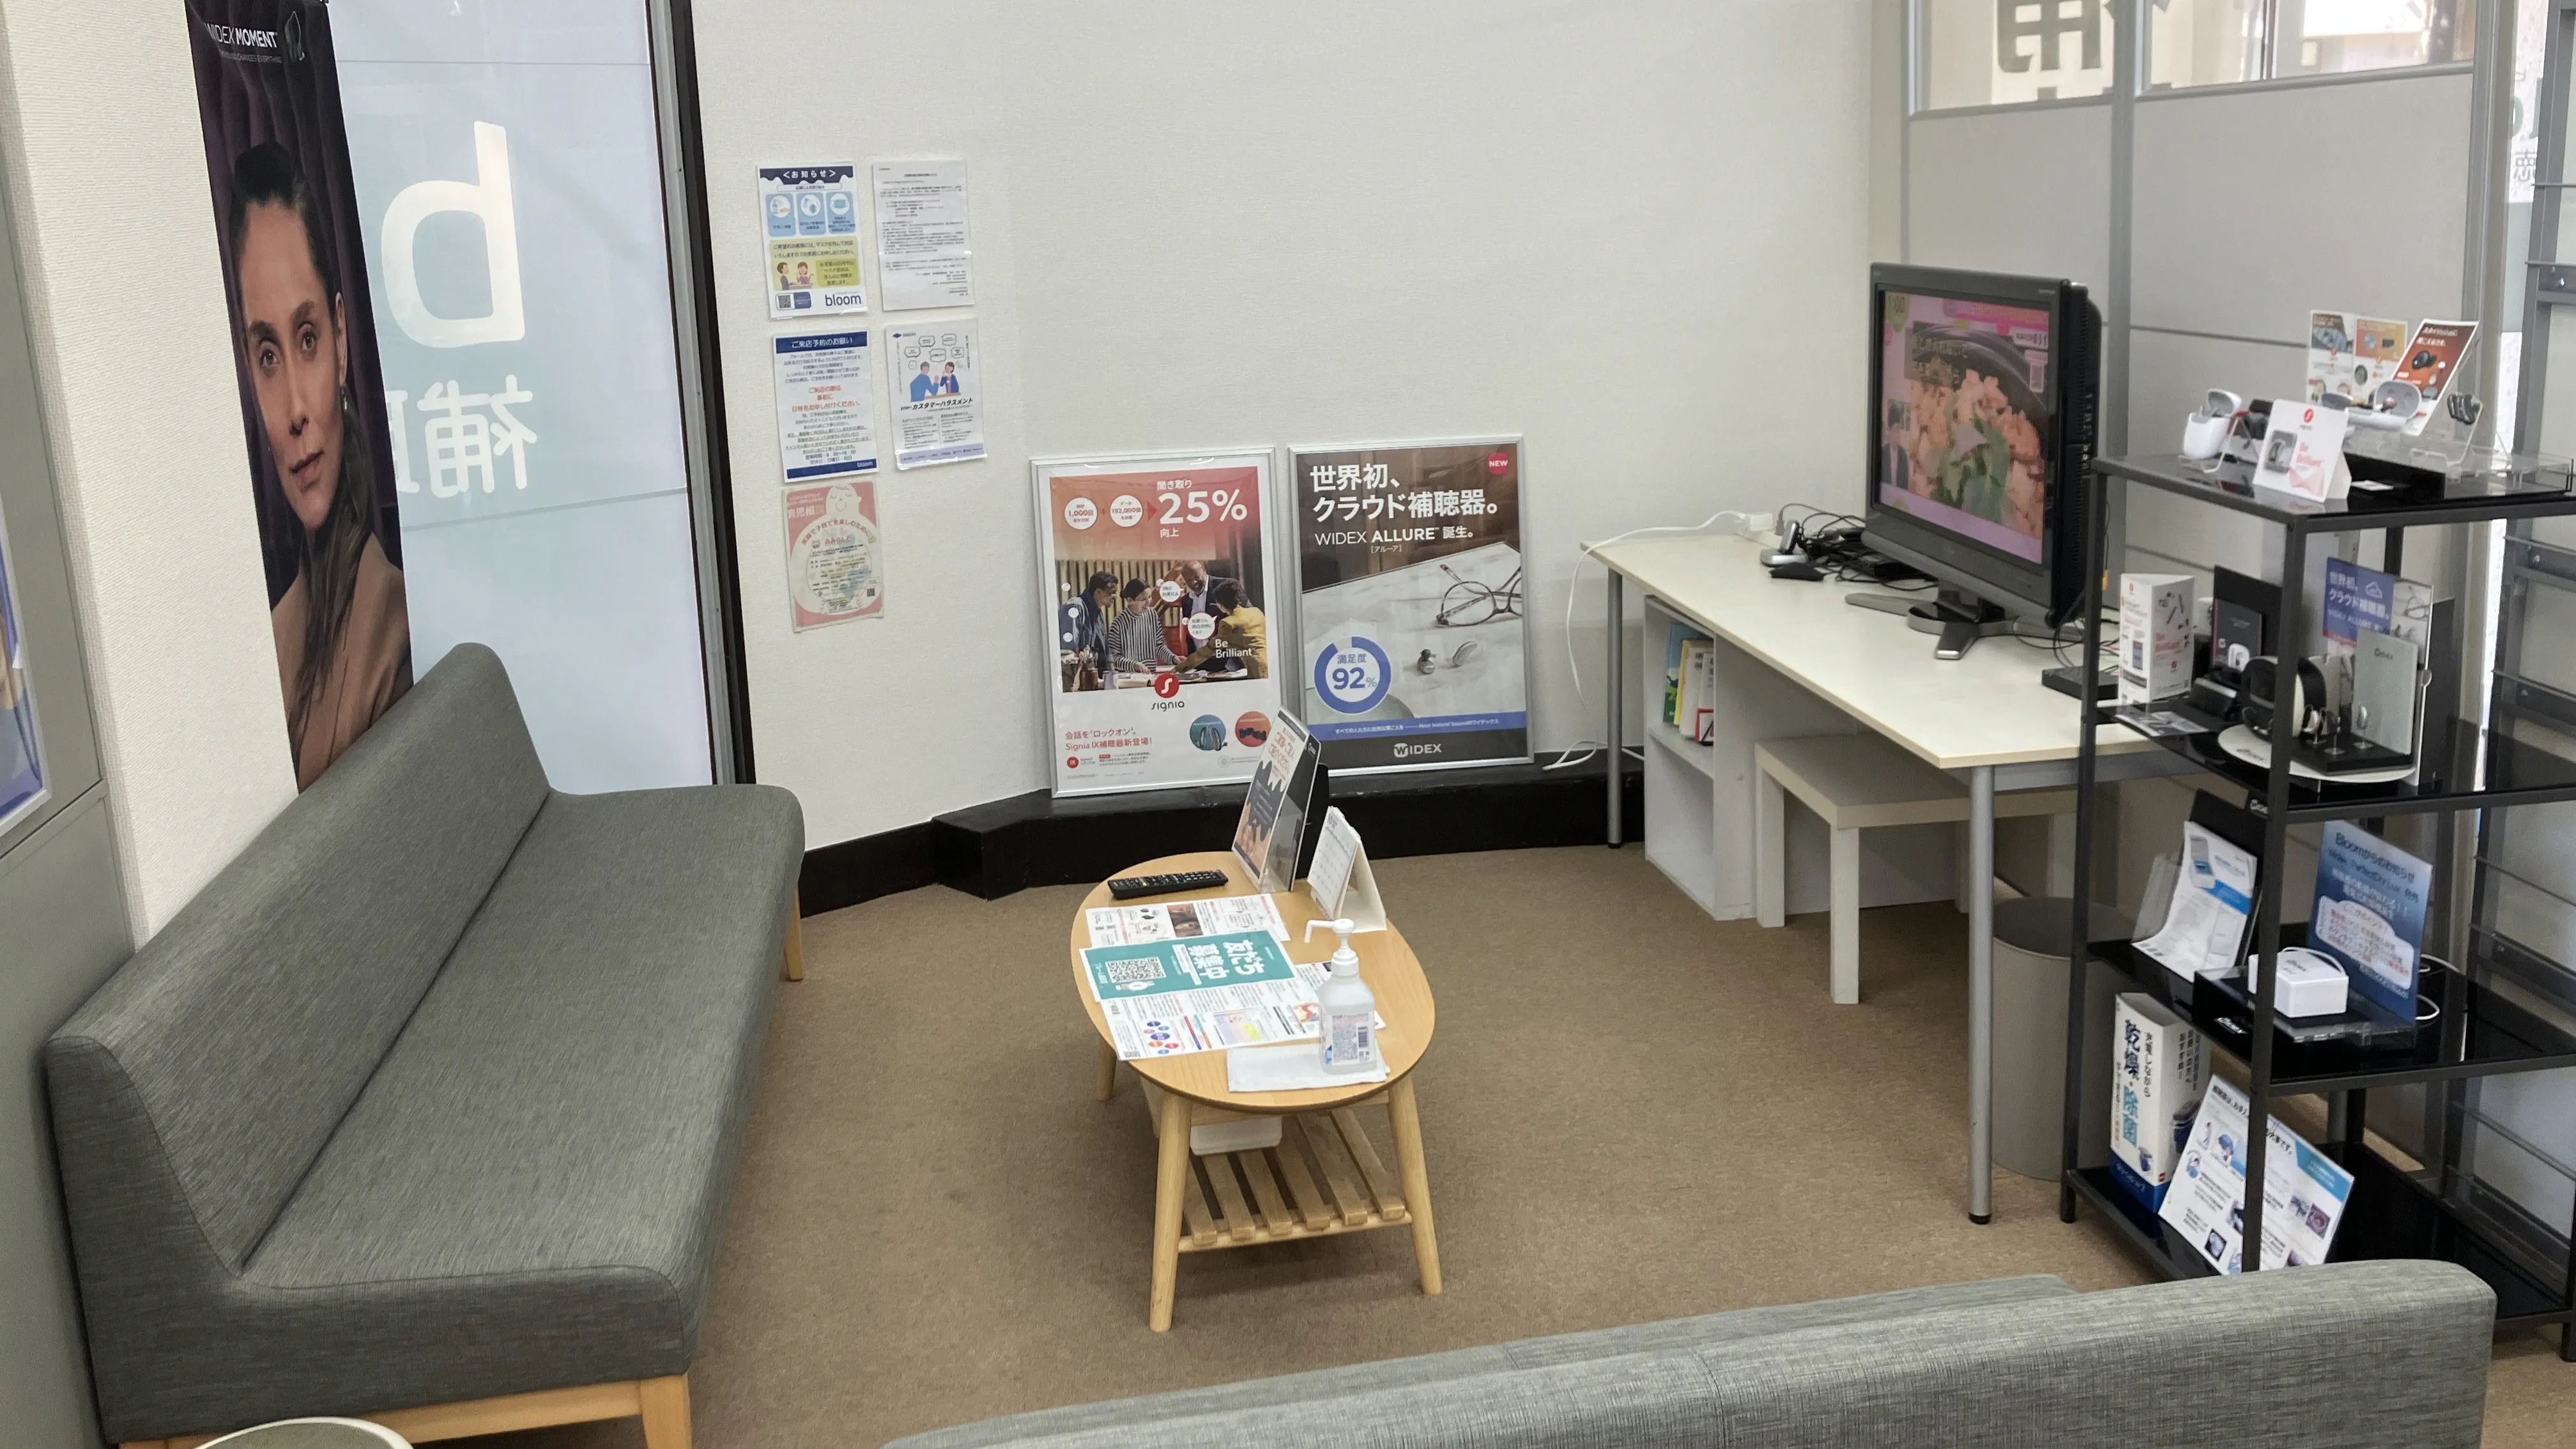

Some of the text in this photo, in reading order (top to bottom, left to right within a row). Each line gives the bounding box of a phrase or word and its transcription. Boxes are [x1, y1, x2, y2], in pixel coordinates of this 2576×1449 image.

[825, 294, 861, 307] bloom
[792, 337, 853, 349] ご来店予約のお願い
[912, 397, 973, 410] カスタマーハラスメント
[1310, 463, 1400, 493] 世界初、
[1156, 479, 1192, 491] 聞き取り
[1157, 489, 1248, 525] 25%
[1313, 489, 1498, 523] クラウド補聴器。
[1160, 527, 1179, 538] 向上
[1315, 531, 1367, 546] WIDEX
[1443, 526, 1473, 539] 誕生。
[1215, 639, 1228, 648] Be
[1337, 654, 1367, 664] 満足度
[1151, 700, 1185, 712] signia
[1066, 743, 1090, 751] Signia
[1393, 743, 1442, 758] WIDEX
[1188, 943, 1230, 980] 募集中
[1223, 939, 1266, 975] 友だち
